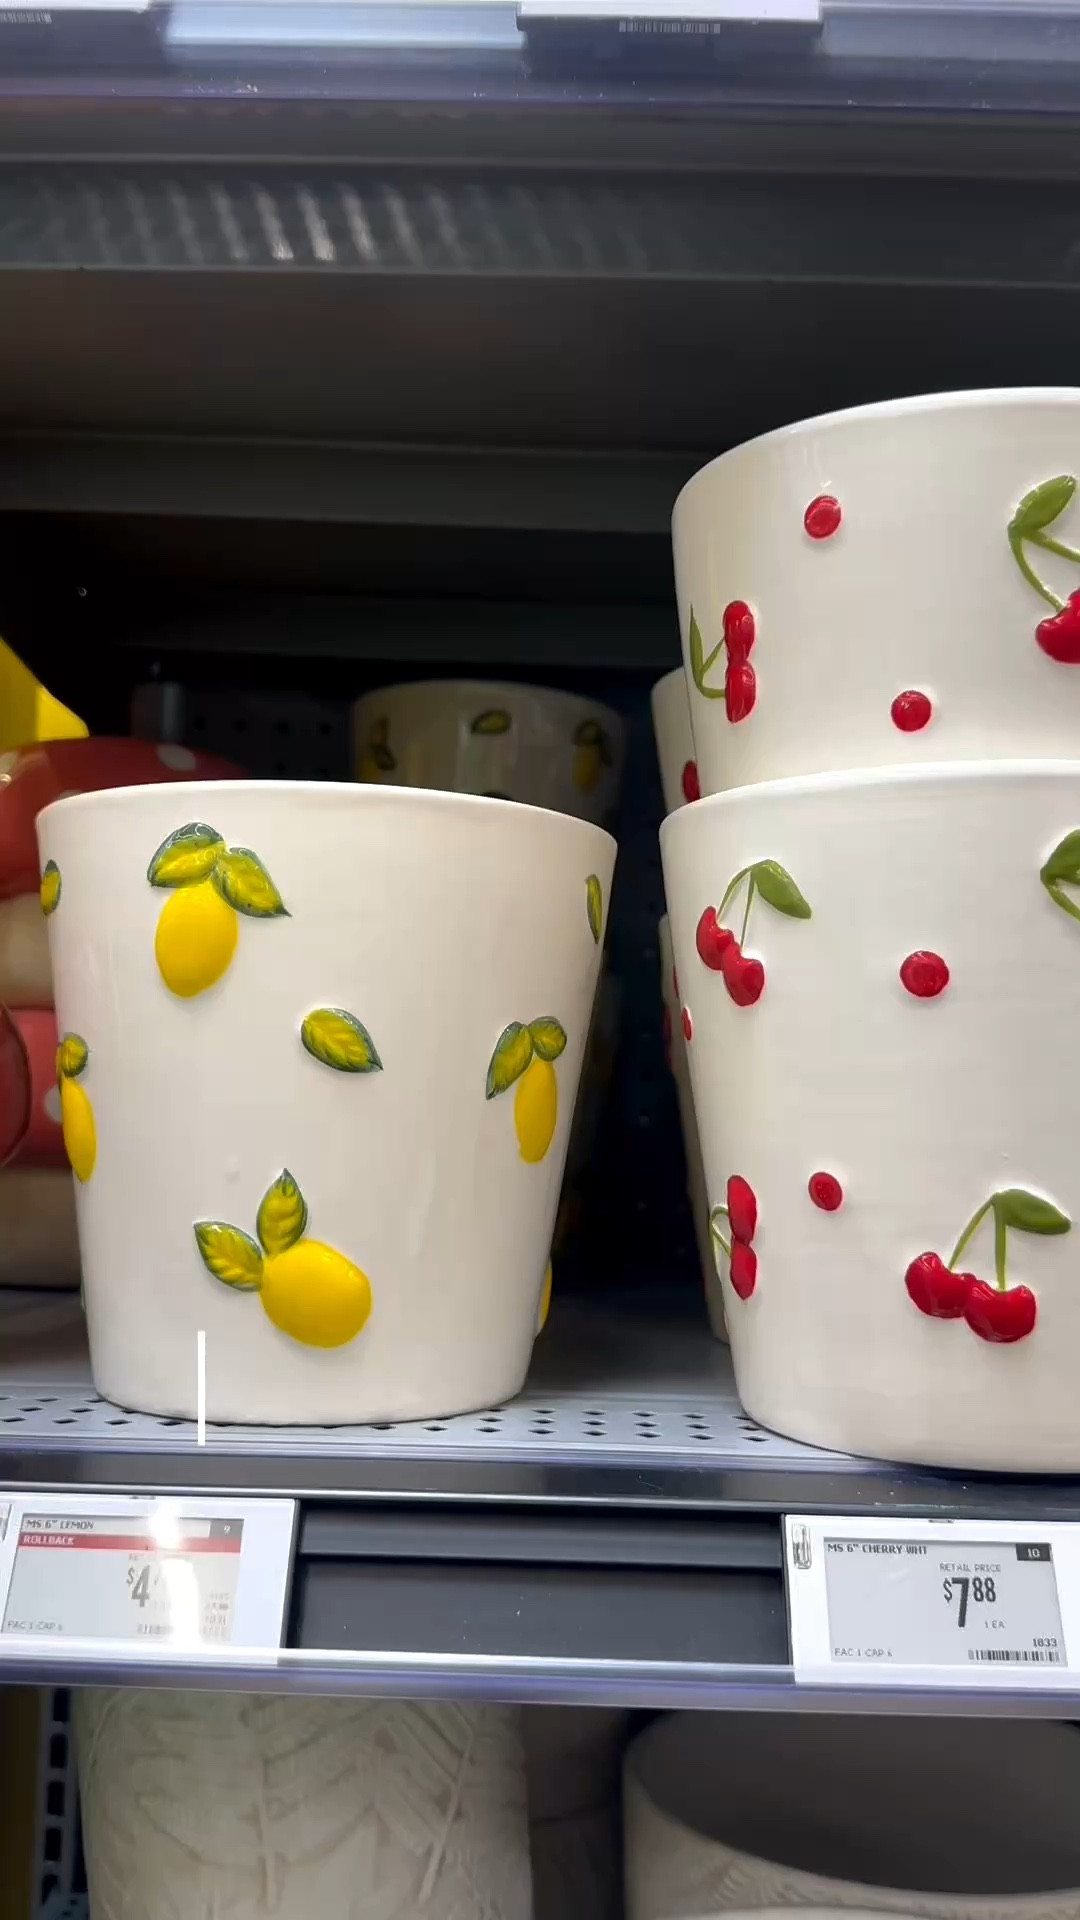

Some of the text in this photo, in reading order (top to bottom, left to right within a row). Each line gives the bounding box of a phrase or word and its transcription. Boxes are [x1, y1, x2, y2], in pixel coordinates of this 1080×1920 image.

[26, 1519, 41, 1529] MS
[60, 1520, 94, 1530] LEMON
[23, 1535, 75, 1545] ROLLBACK
[827, 1543, 844, 1553] MS
[862, 1544, 903, 1554] CHERRY
[906, 1545, 928, 1555] WHT
[1027, 1548, 1041, 1558] 10
[939, 1563, 1001, 1573] RETAIL PRICE
[992, 1620, 1006, 1629] EA
[1032, 1637, 1058, 1648] 1833
[834, 1647, 854, 1657] FAC
[864, 1648, 884, 1657] CAP
